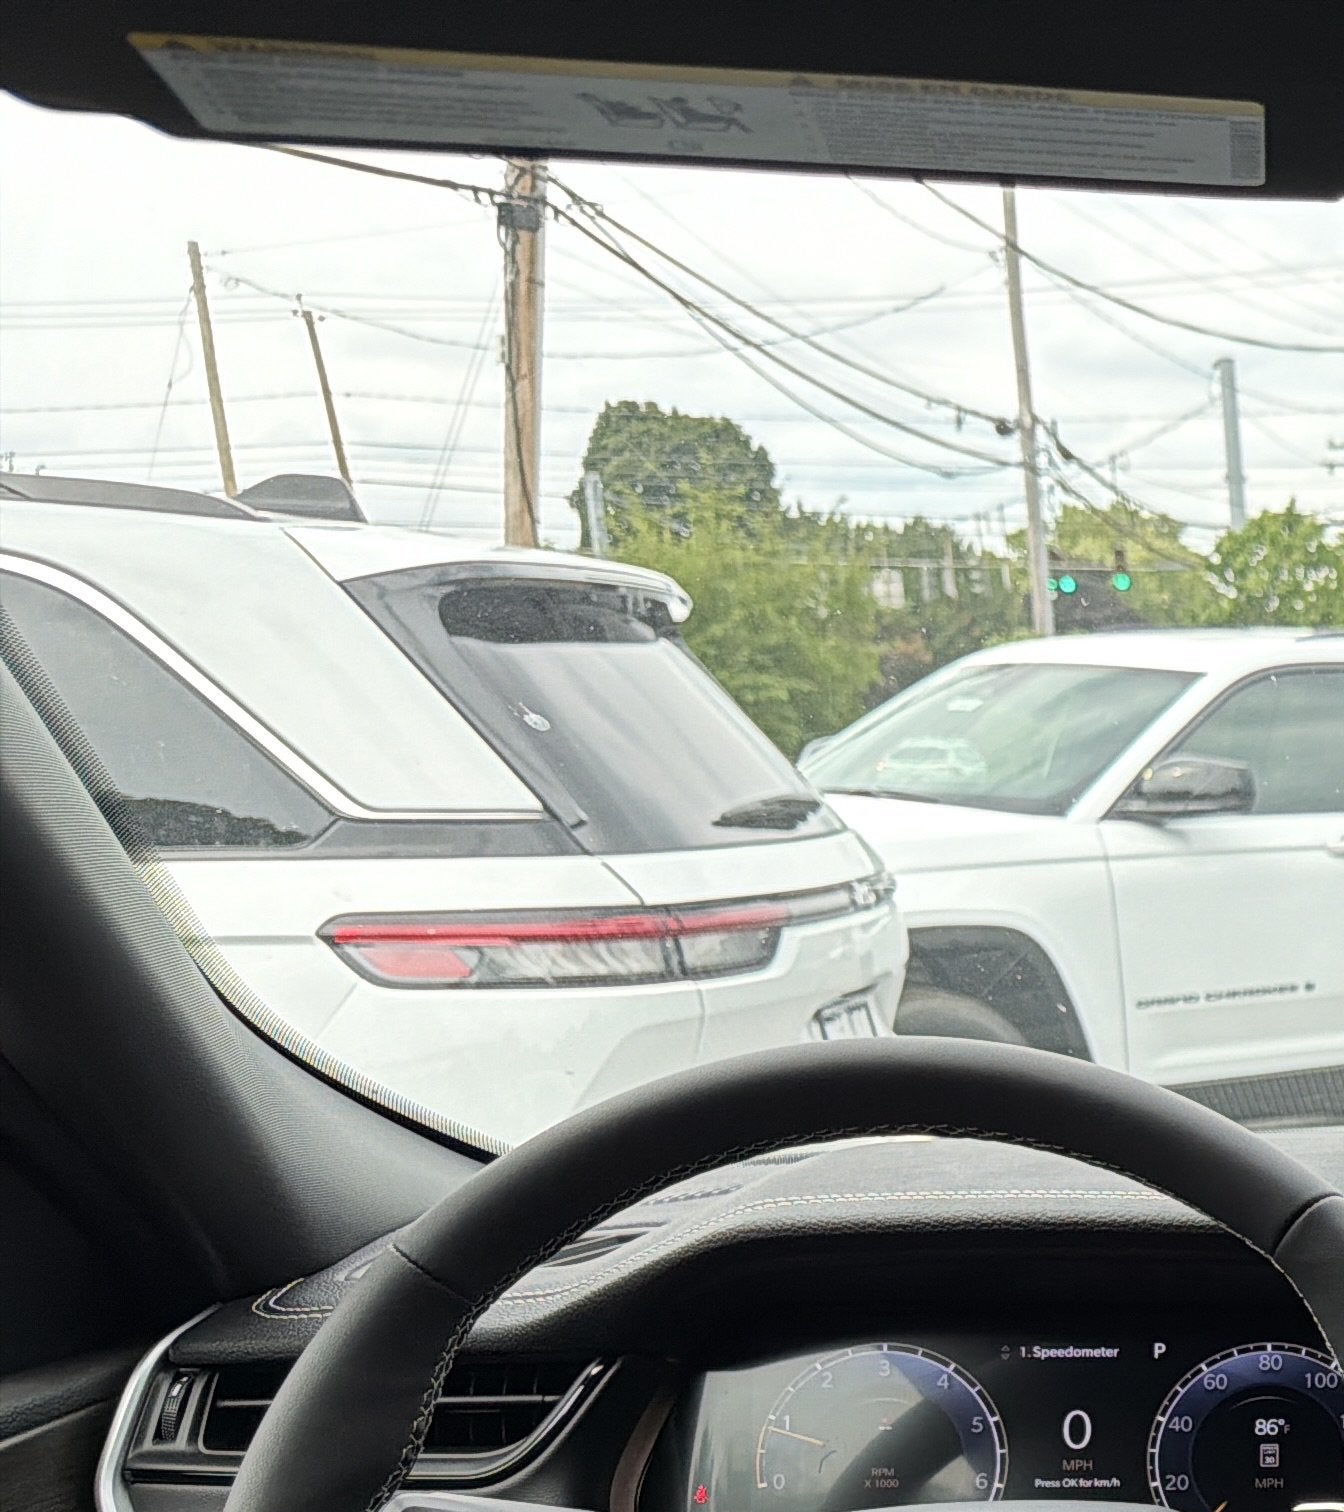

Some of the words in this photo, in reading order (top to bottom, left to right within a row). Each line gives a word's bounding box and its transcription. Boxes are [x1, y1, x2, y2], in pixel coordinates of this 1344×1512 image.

[1154, 1344, 1166, 1359] P
[879, 1360, 891, 1376] 3
[1259, 1355, 1283, 1371] 80
[821, 1373, 834, 1389] 2
[936, 1374, 949, 1389] 4
[1203, 1374, 1228, 1391] 60
[1304, 1373, 1339, 1389] 100
[783, 1415, 790, 1431] 1
[972, 1417, 984, 1433] 5
[1062, 1409, 1092, 1450] 0
[1169, 1416, 1193, 1433] 40
[872, 1467, 895, 1477] RPM
[1062, 1459, 1093, 1471] MPH
[773, 1474, 786, 1489] 0
[864, 1480, 872, 1488] X
[874, 1479, 899, 1488] 1000
[975, 1474, 988, 1489] 6
[1034, 1478, 1060, 1488] Press
[1062, 1478, 1078, 1488] OK
[1079, 1478, 1093, 1488] for
[1094, 1477, 1121, 1488] km/h
[1165, 1475, 1189, 1491] 20
[1254, 1477, 1284, 1489] MPH
